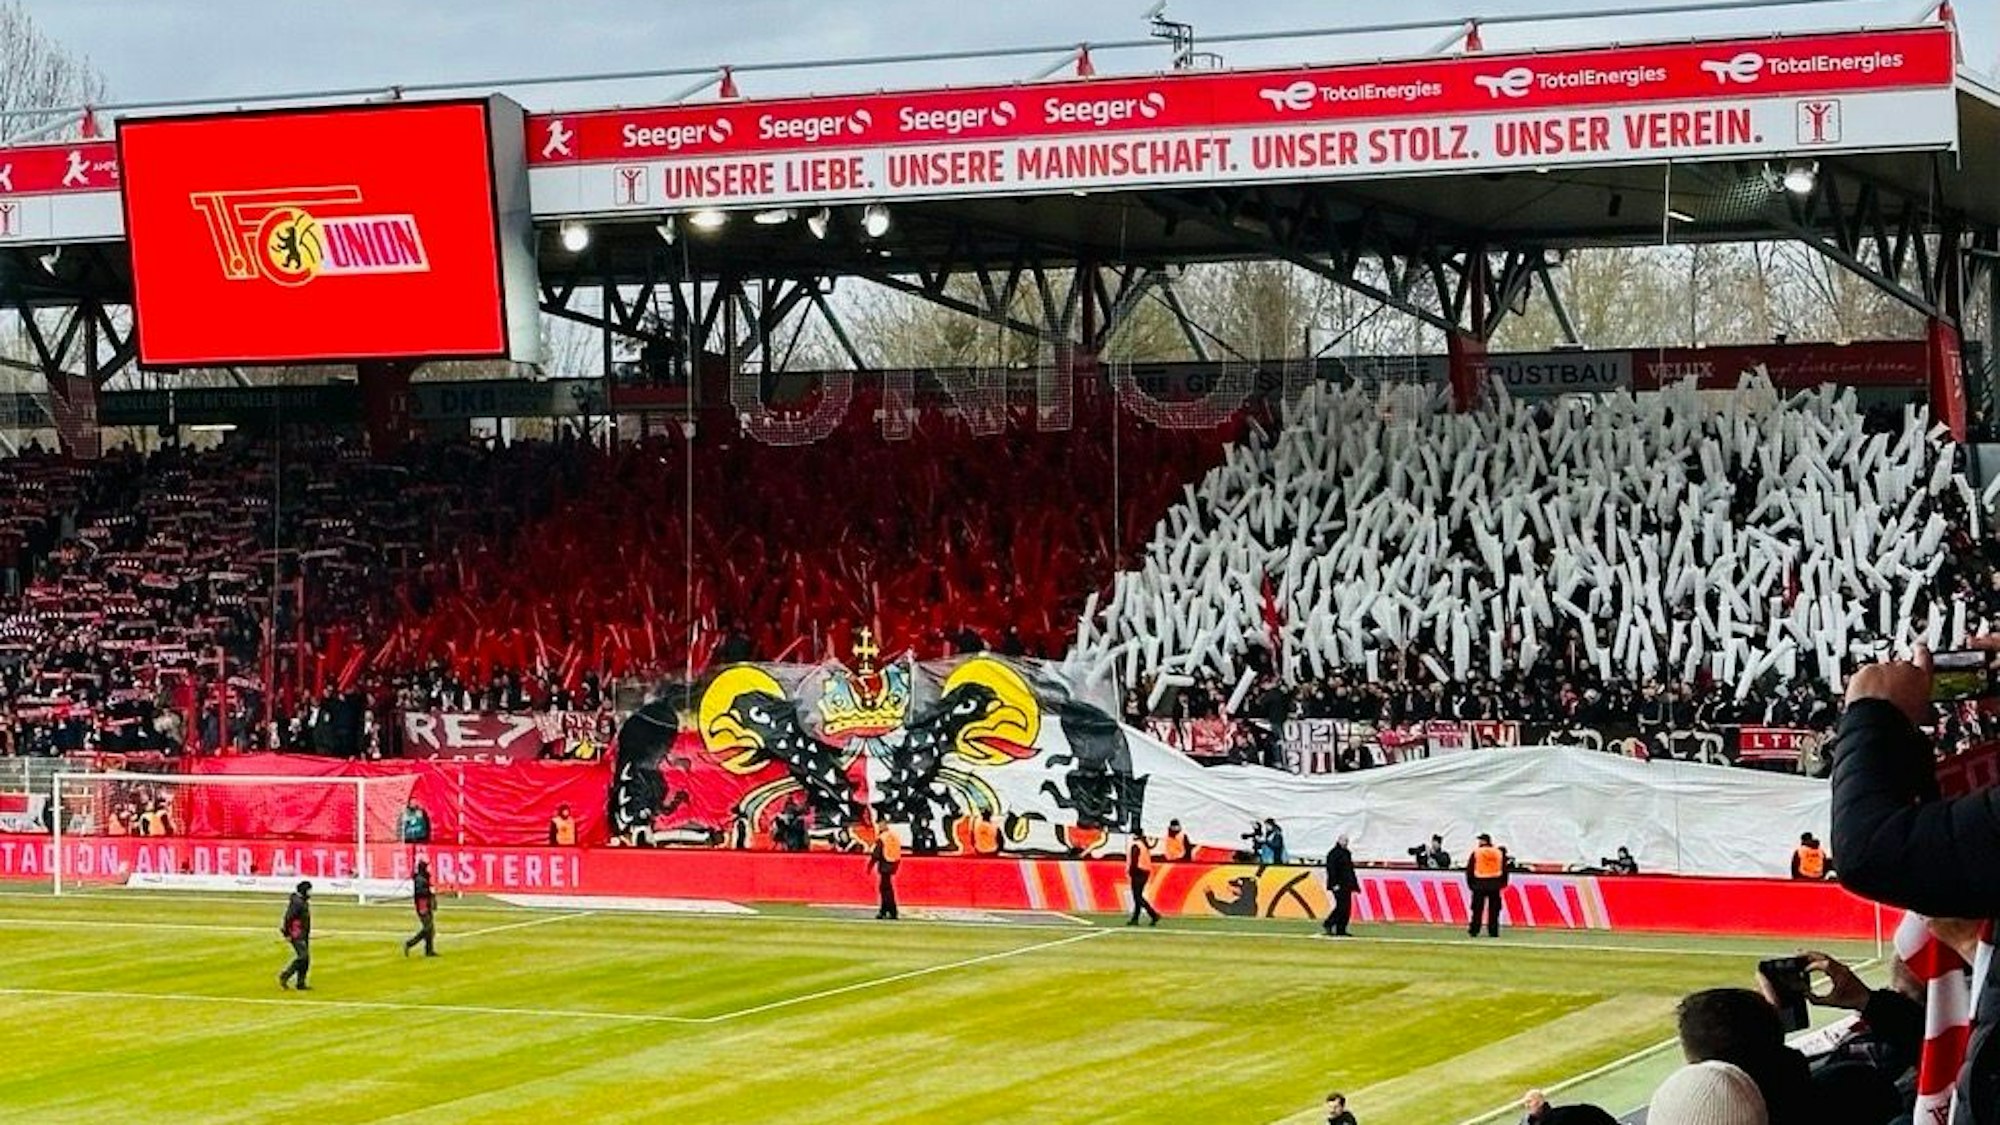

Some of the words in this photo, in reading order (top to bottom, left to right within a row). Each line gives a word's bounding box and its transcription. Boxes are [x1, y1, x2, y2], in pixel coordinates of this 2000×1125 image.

[1536, 65, 1667, 89] TotalEnergies
[1767, 51, 1904, 76] TotalEnergies
[1319, 80, 1442, 101] TotalEnergies
[899, 104, 989, 133] Seeger
[1043, 97, 1138, 126] Seeger
[622, 122, 706, 150] Seeger
[759, 113, 847, 142] Seeger
[665, 163, 774, 199] UNSERE
[785, 157, 876, 193] LIEBE.
[888, 149, 1004, 188] UNSERE
[1016, 137, 1239, 181] MANNSCHAFT.
[1252, 131, 1359, 170] UNSER
[1368, 124, 1479, 164] STOLZ.
[1495, 116, 1611, 157] UNSER
[1623, 107, 1763, 149] VEREIN.
[322, 220, 423, 269] UNION
[136, 845, 175, 874] AN
[194, 846, 256, 875] DER
